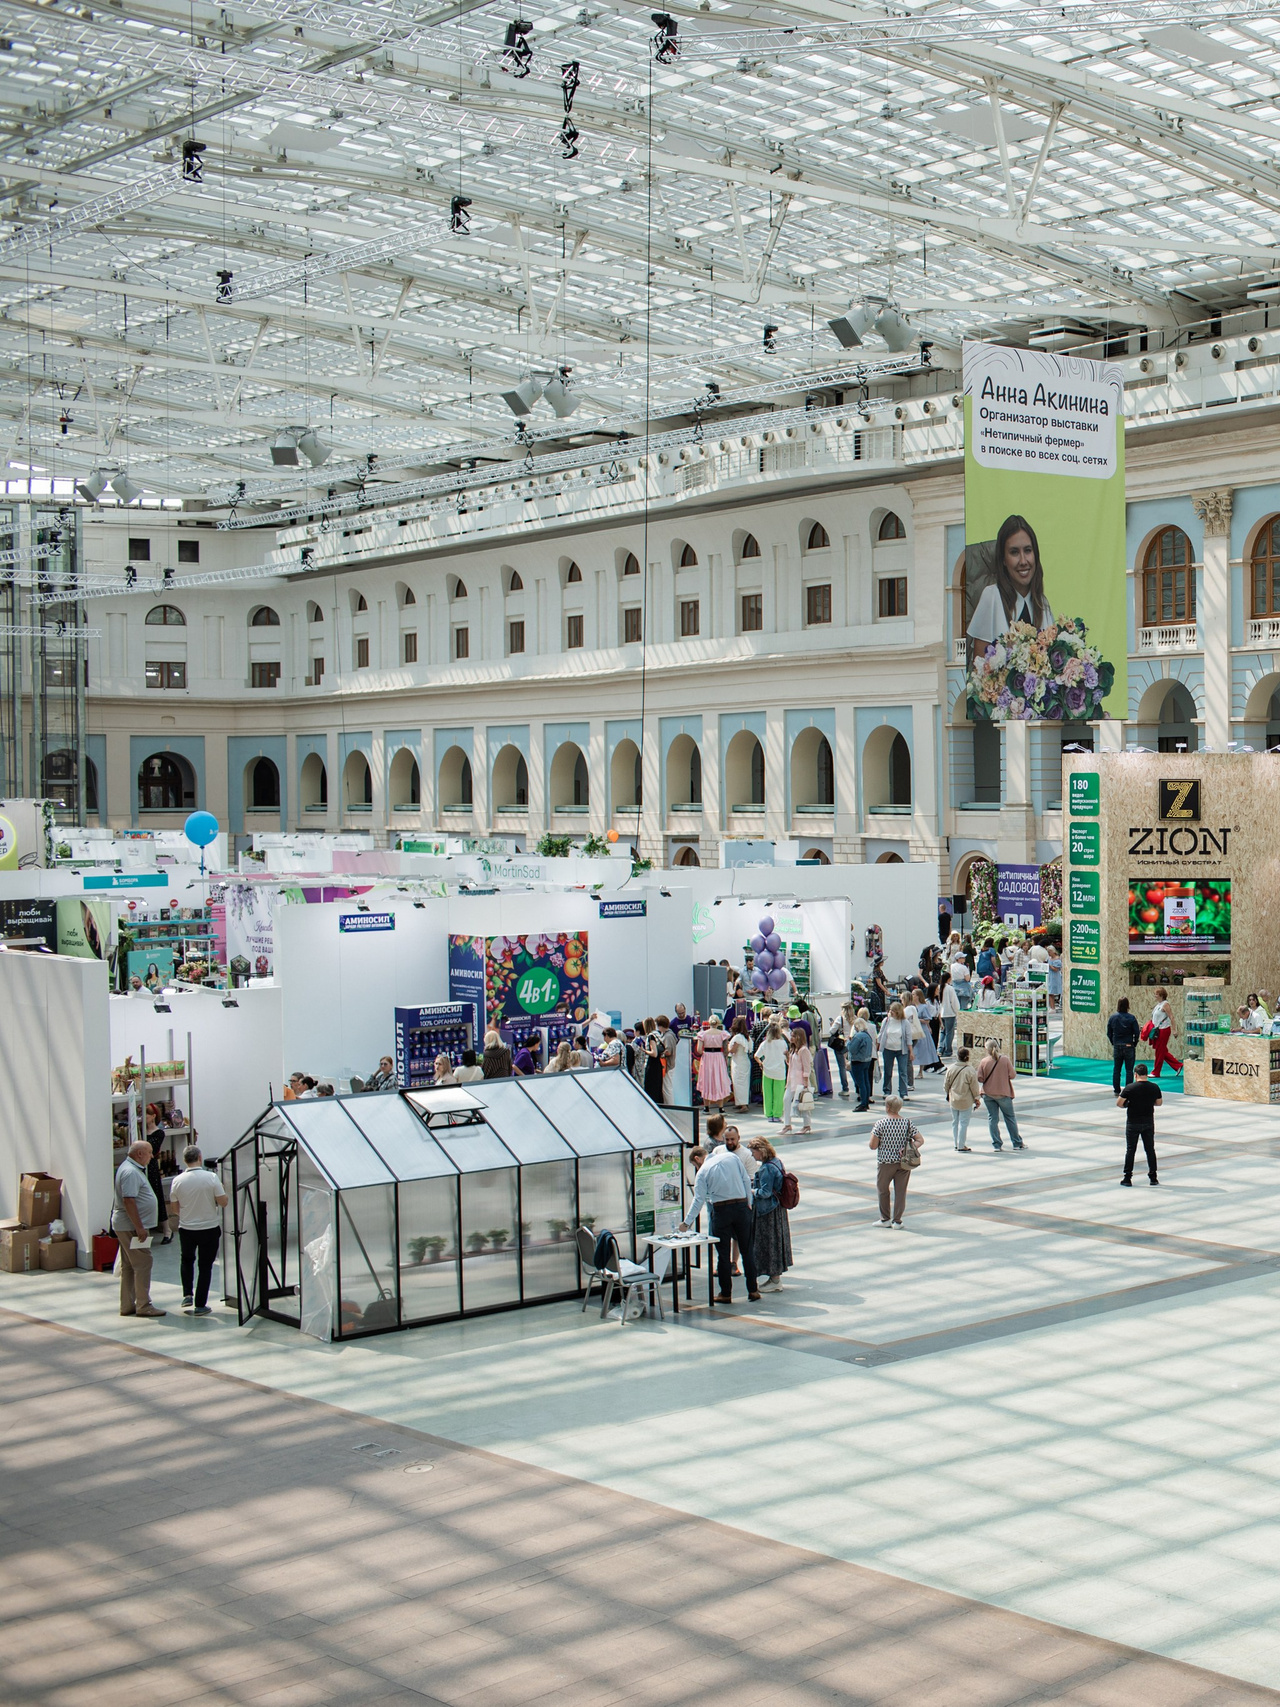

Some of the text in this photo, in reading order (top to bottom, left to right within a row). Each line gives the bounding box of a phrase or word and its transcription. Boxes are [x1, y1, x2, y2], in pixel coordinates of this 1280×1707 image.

[980, 375, 1109, 416] Анна Акинина
[979, 407, 1099, 432] Организатор выставки
[980, 427, 1085, 449] «Нетипичный фермер»
[981, 445, 1108, 466] в поиске во всех соц. сетях
[1072, 780, 1088, 790] 180
[1166, 782, 1194, 818] Z
[1128, 827, 1231, 855] ZION
[1072, 842, 1083, 852] 20
[494, 864, 540, 879] MartinSad
[998, 881, 1039, 895] САДОВОД
[1072, 891, 1083, 901] 12
[19, 908, 40, 916] люби
[604, 903, 642, 911] АМИНОСИЛ
[7, 915, 52, 925] выращивай
[345, 916, 390, 925] АМИНОСИЛ
[67, 928, 78, 937] люби
[61, 939, 84, 947] выращивай
[1085, 946, 1096, 955] 4.9
[450, 968, 483, 979] АМИНОСИЛ
[1077, 975, 1083, 986] 7
[419, 1005, 463, 1016] АМИНОСИЛ
[433, 1018, 462, 1026] ОРГАНИКА
[396, 1022, 405, 1086] НОСИЛ
[1225, 1062, 1259, 1077] ZION
